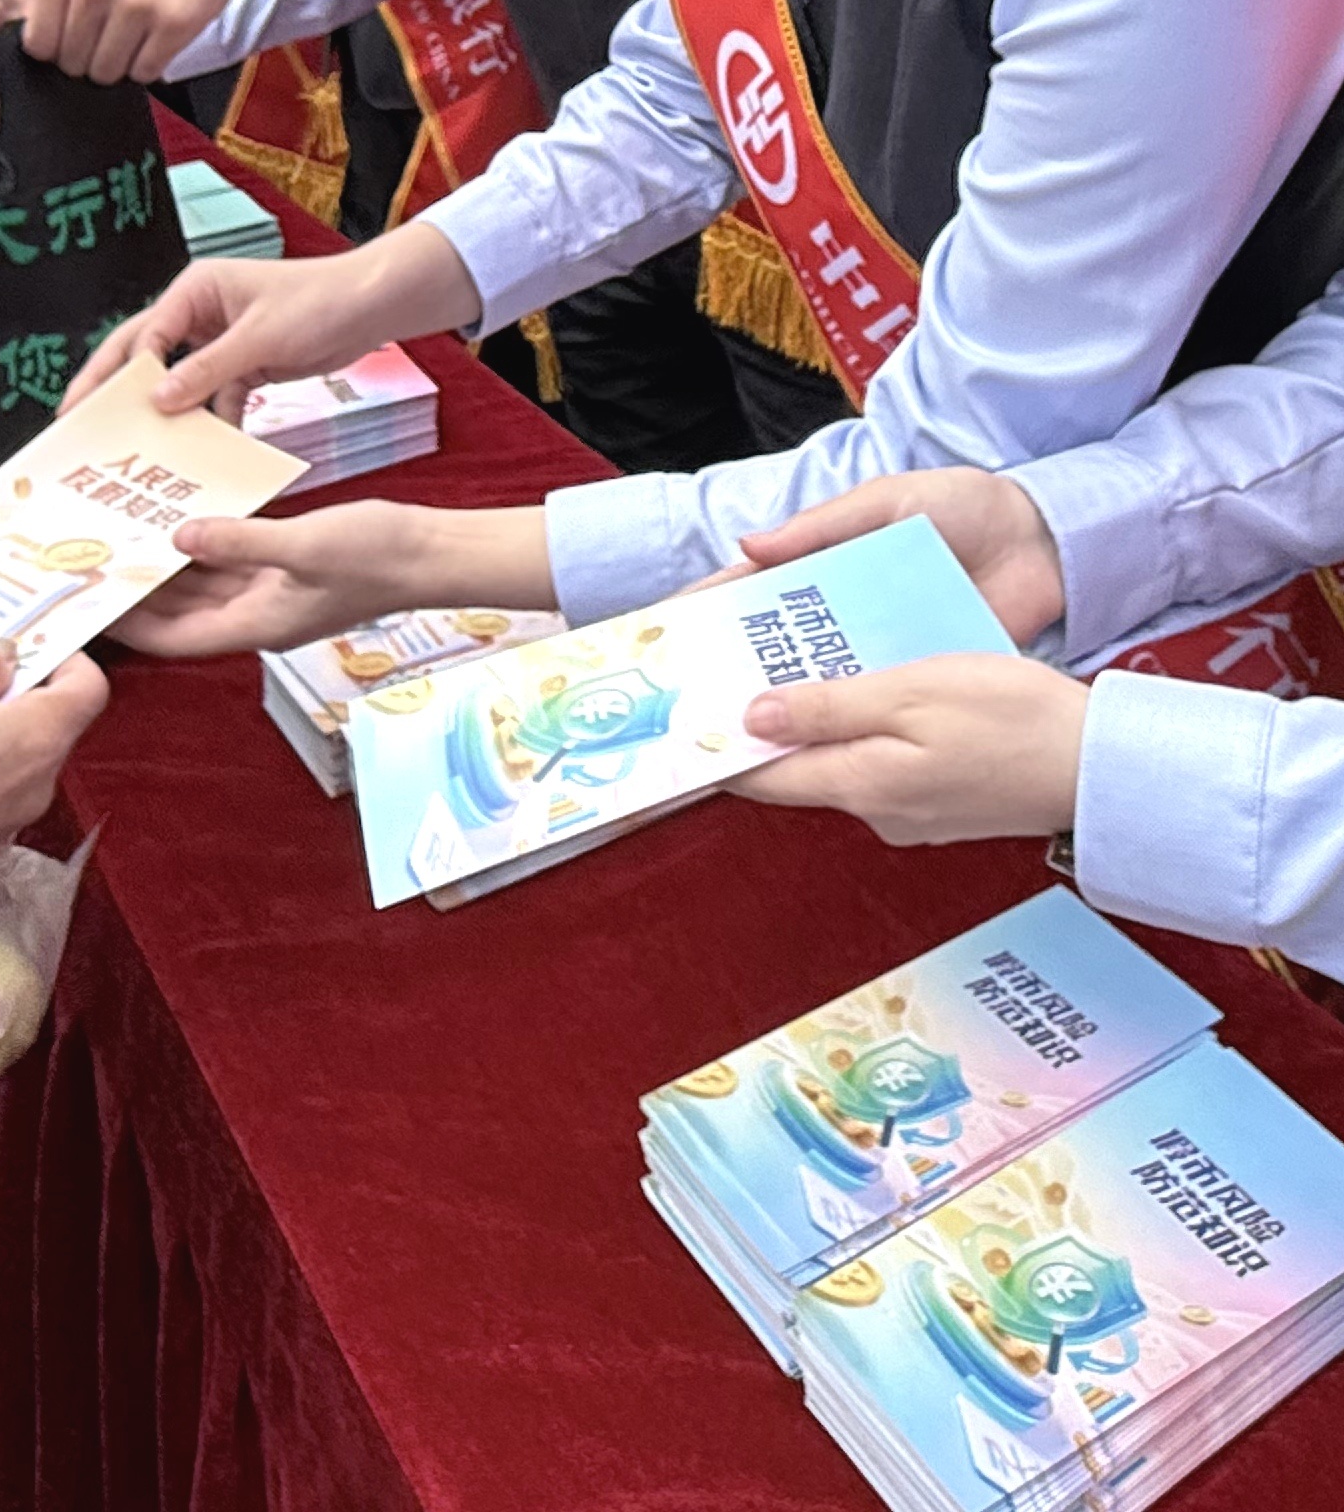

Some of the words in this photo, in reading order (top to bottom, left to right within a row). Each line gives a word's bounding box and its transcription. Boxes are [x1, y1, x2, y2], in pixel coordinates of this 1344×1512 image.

[102, 452, 203, 501] 人民币
[963, 975, 1084, 1069] 防范知识
[982, 950, 1100, 1041] 假币风险
[1130, 1159, 1271, 1278] 防范知识
[1149, 1127, 1286, 1244] 假币风险
